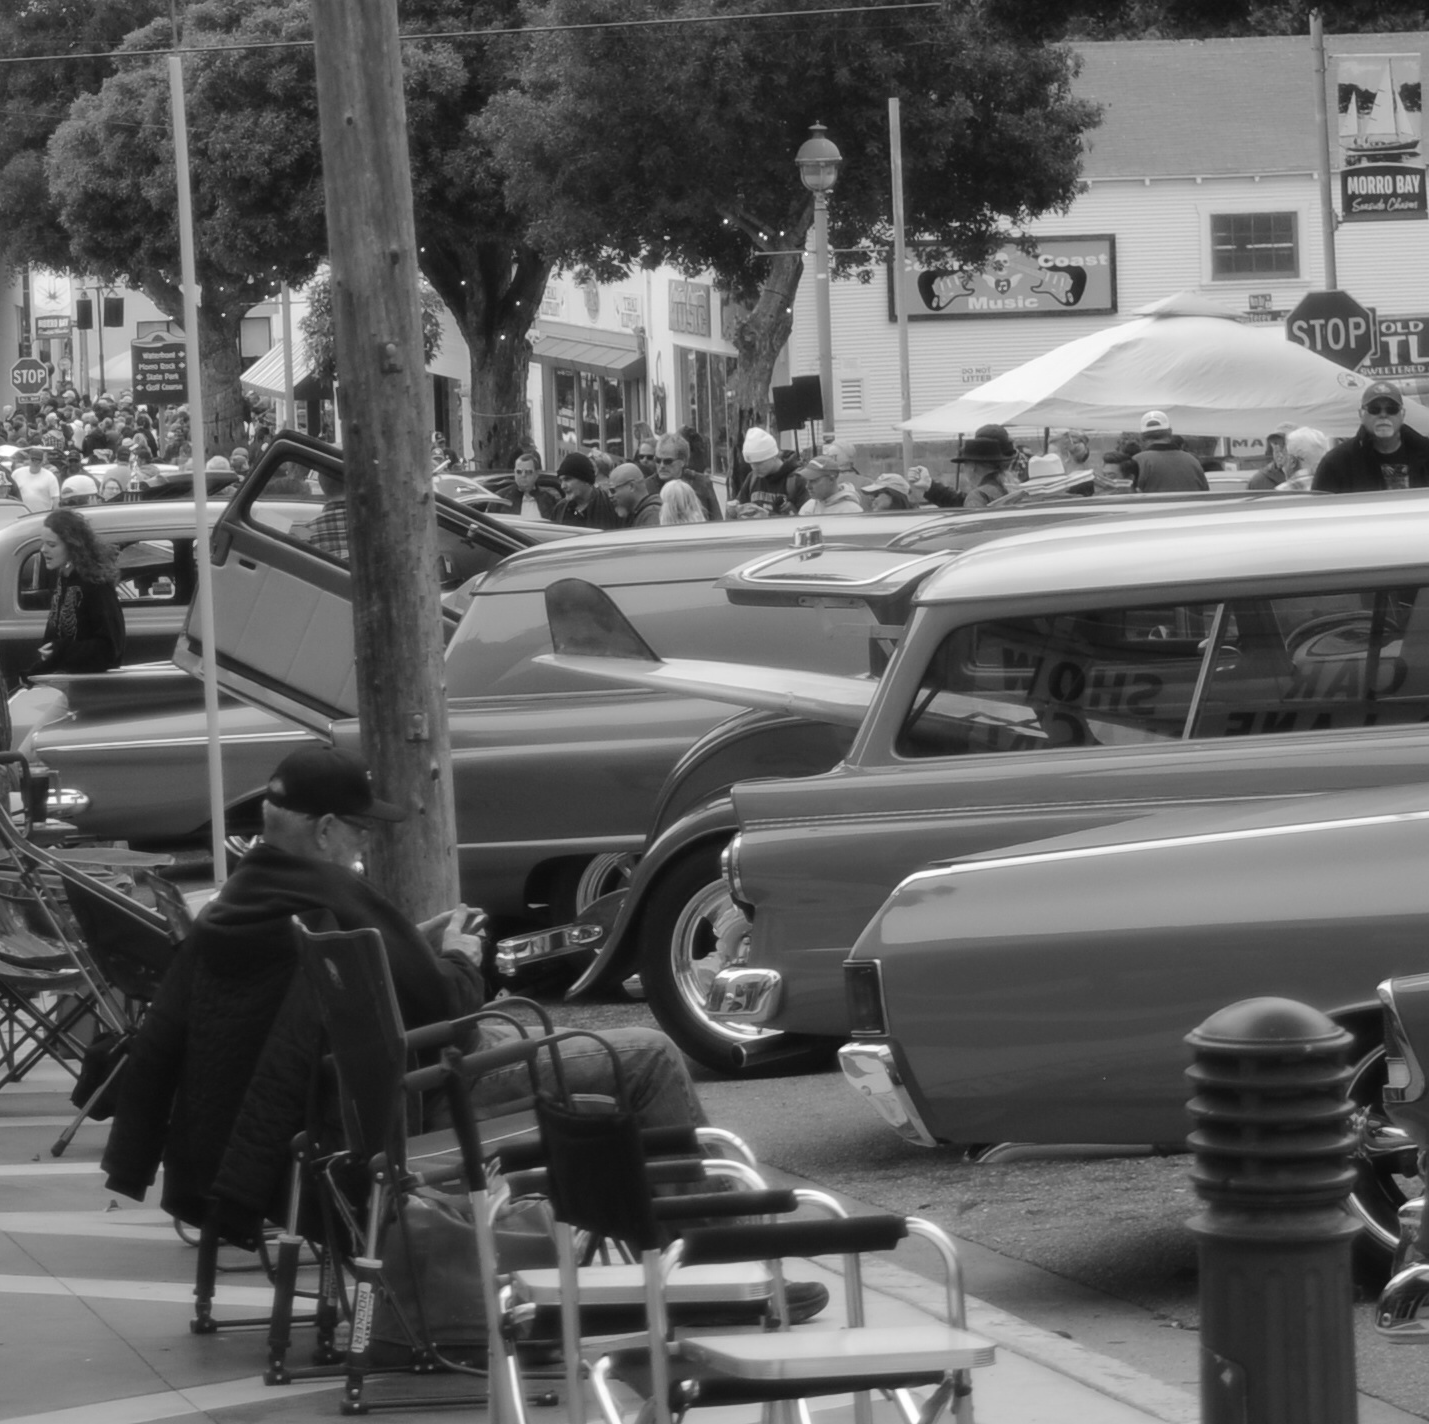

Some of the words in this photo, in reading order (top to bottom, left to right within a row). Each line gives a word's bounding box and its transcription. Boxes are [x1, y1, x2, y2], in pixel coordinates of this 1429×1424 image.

[1346, 175, 1394, 195] MORRO
[1395, 174, 1420, 194] BAY
[1037, 252, 1109, 268] Coast
[968, 296, 1039, 310] Music
[1291, 317, 1366, 352] STOP
[1380, 320, 1424, 334] OLD
[1362, 334, 1429, 366] TL
[160, 361, 176, 370] Rock
[1359, 365, 1426, 375] SWEETENED
[13, 368, 46, 385] STOP
[146, 372, 163, 381] State
[164, 372, 180, 381] Park
[161, 382, 183, 391] Course
[353, 1289, 367, 1345] ROCKER
